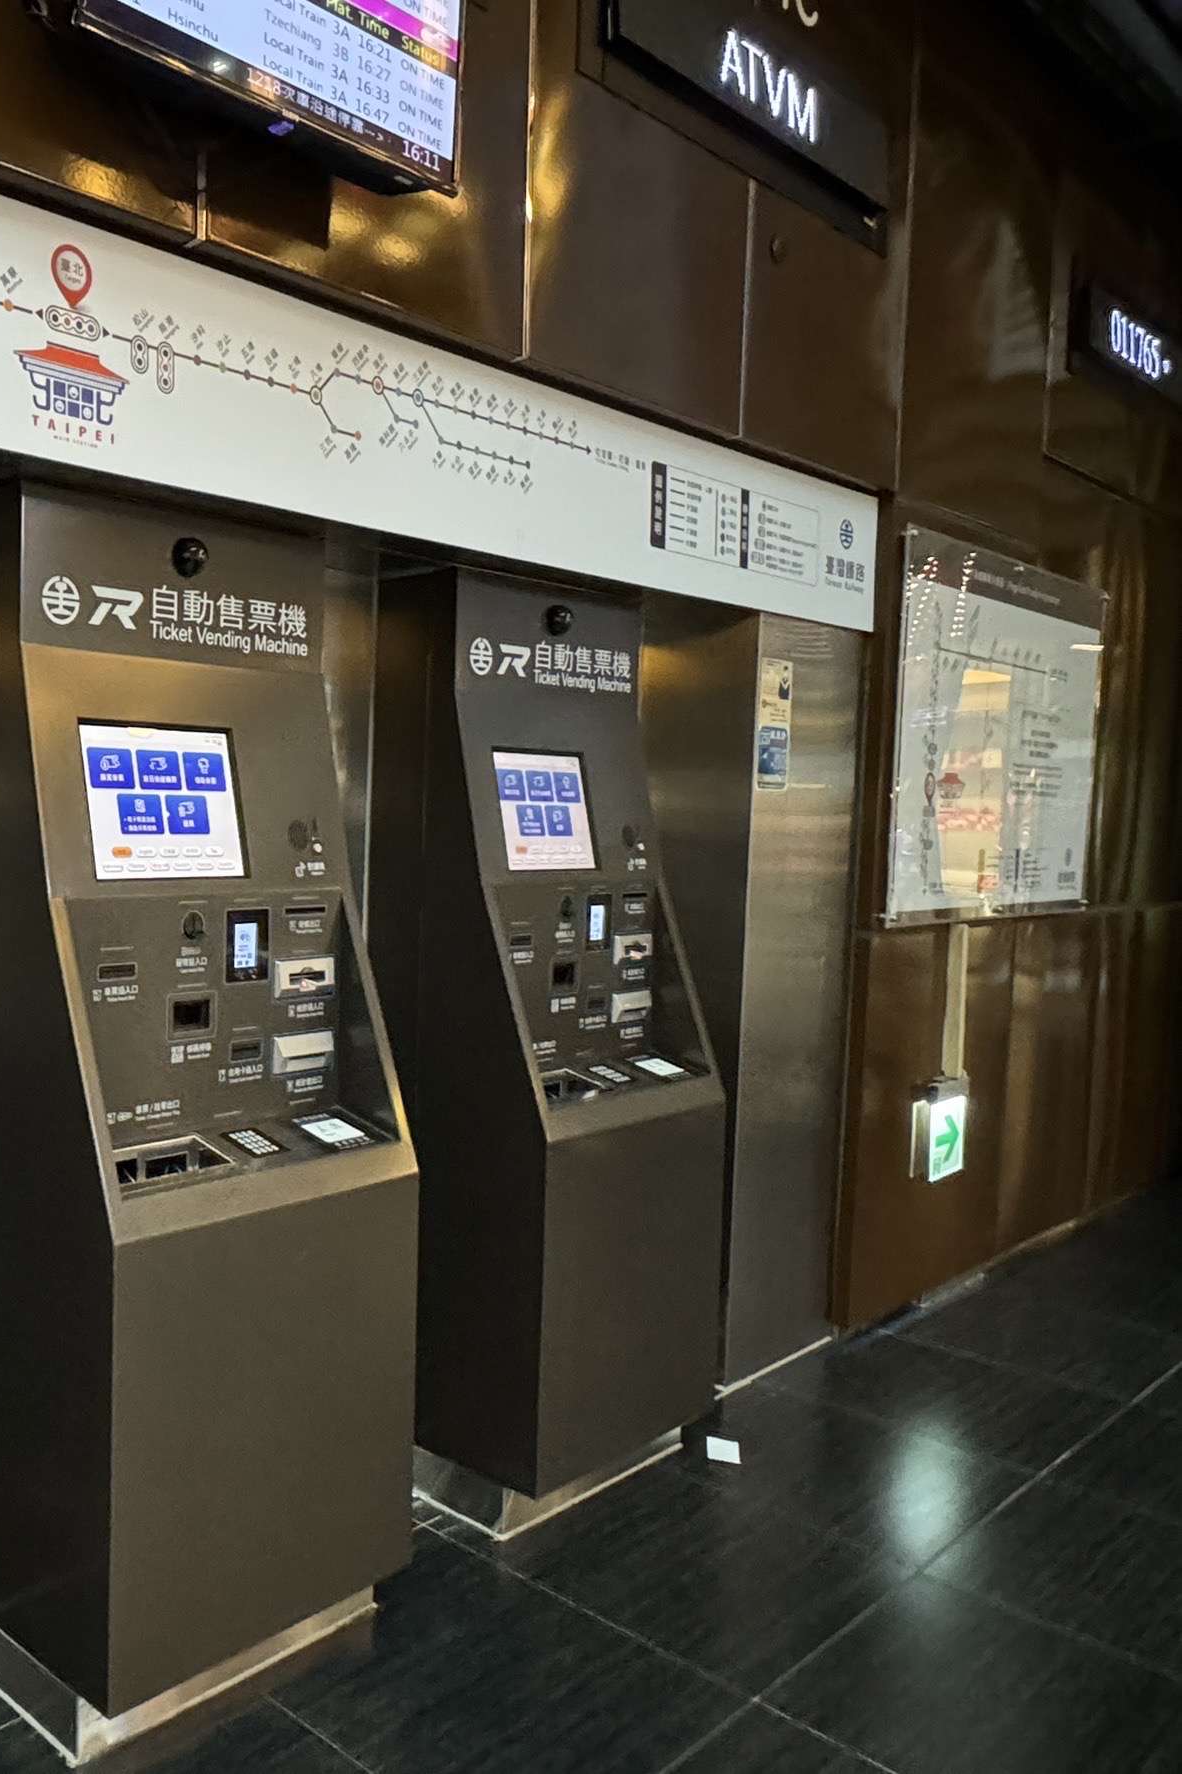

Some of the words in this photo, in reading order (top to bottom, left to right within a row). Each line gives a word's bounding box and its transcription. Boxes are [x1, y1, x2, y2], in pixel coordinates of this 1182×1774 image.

[265, 8, 322, 51] Tzechiang
[332, 42, 349, 62] 3B
[358, 55, 391, 82] 16:27
[400, 80, 417, 97] ON
[420, 89, 444, 111] TIME
[299, 3, 327, 27] Train
[332, 19, 350, 41] 3A
[358, 34, 392, 63] 16:21
[400, 58, 418, 75] ON
[421, 68, 446, 90] TIME
[358, 10, 390, 39] Time
[401, 36, 440, 67] Status
[168, 7, 219, 43] Hsinchu
[263, 31, 295, 56] Local
[296, 48, 325, 71] Train
[331, 63, 349, 84] 3A
[357, 76, 390, 105] 16:33
[399, 100, 417, 117] ON
[420, 110, 443, 132] TIME
[720, 27, 816, 143] ATVM
[262, 54, 294, 79] Local
[296, 70, 324, 93] Train
[330, 85, 348, 106] 3A
[356, 98, 390, 124] 16:47
[398, 121, 415, 138] ON
[418, 130, 443, 151] TIME
[402, 139, 441, 172] 16:11
[32, 414, 115, 445] TAIPEI
[149, 620, 193, 643] Ticket
[197, 629, 251, 654] Vending
[254, 636, 308, 657] Machine
[151, 585, 307, 639] 自動售票機
[533, 669, 561, 687] Ticket
[562, 674, 596, 694] Vending
[597, 678, 632, 694] Machine
[534, 641, 632, 679] 自動售票機
